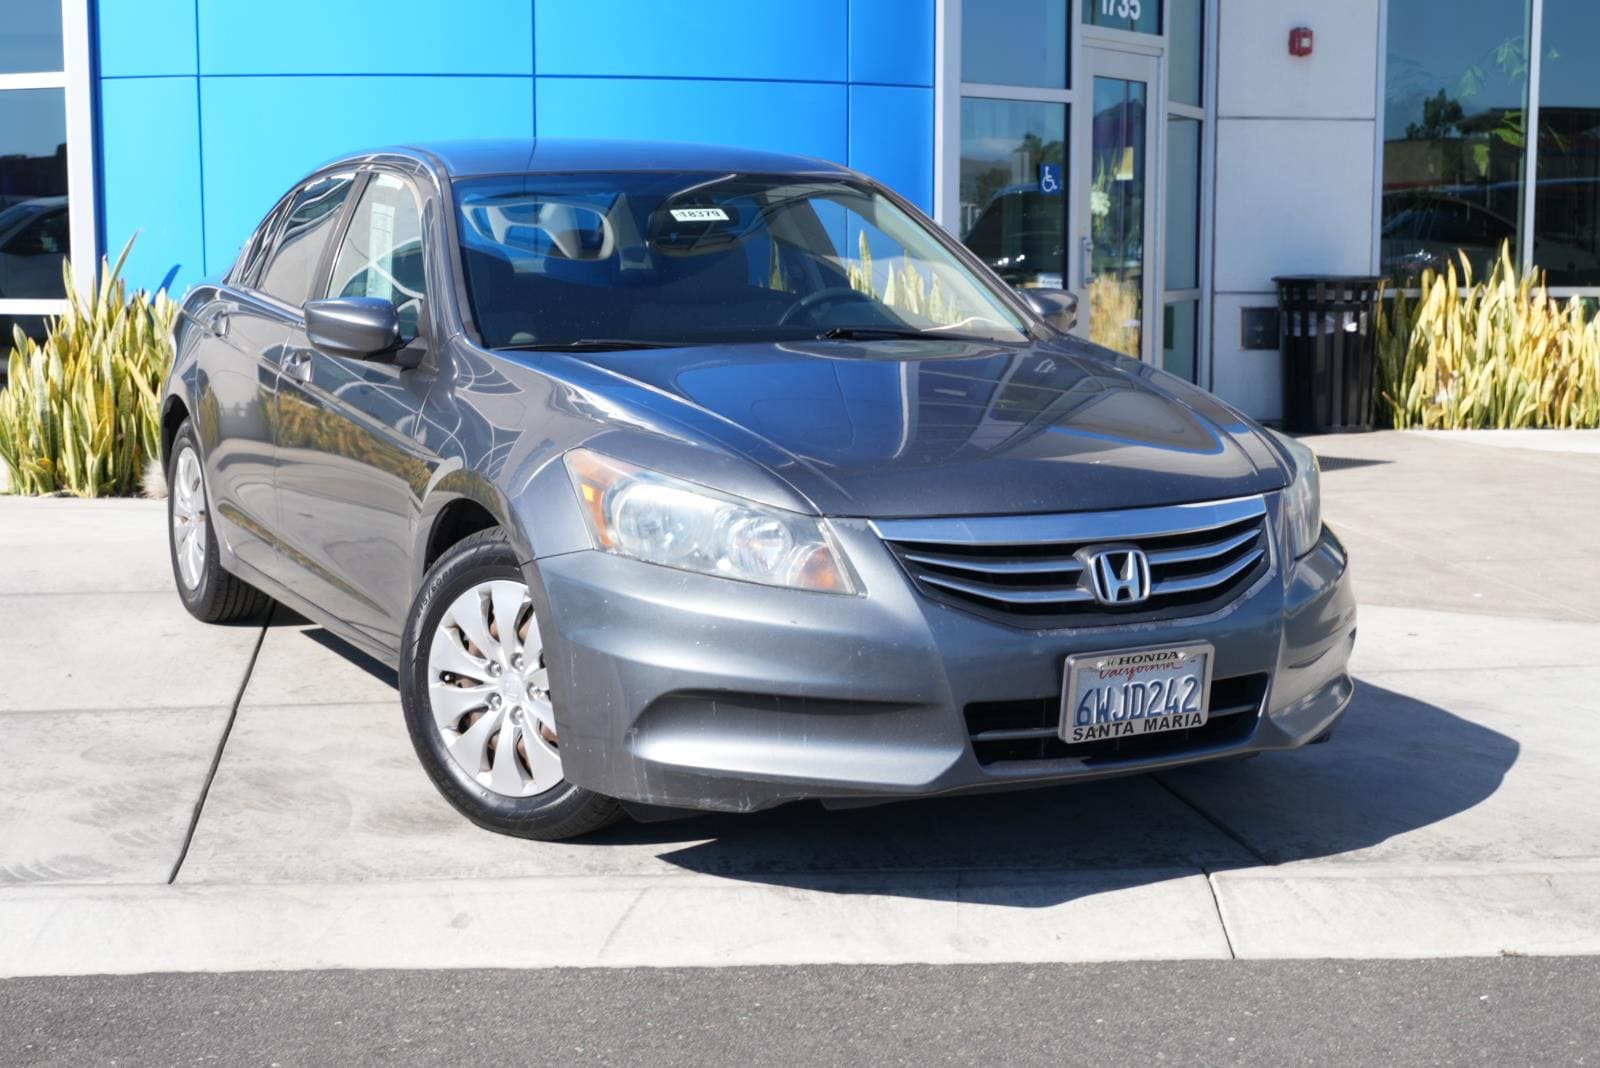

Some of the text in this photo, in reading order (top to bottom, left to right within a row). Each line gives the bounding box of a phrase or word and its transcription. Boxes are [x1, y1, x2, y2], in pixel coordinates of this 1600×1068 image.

[1118, 651, 1178, 666] HONDA
[1076, 675, 1197, 726] 6WJD242
[1073, 712, 1202, 741] SANTA MARIA
